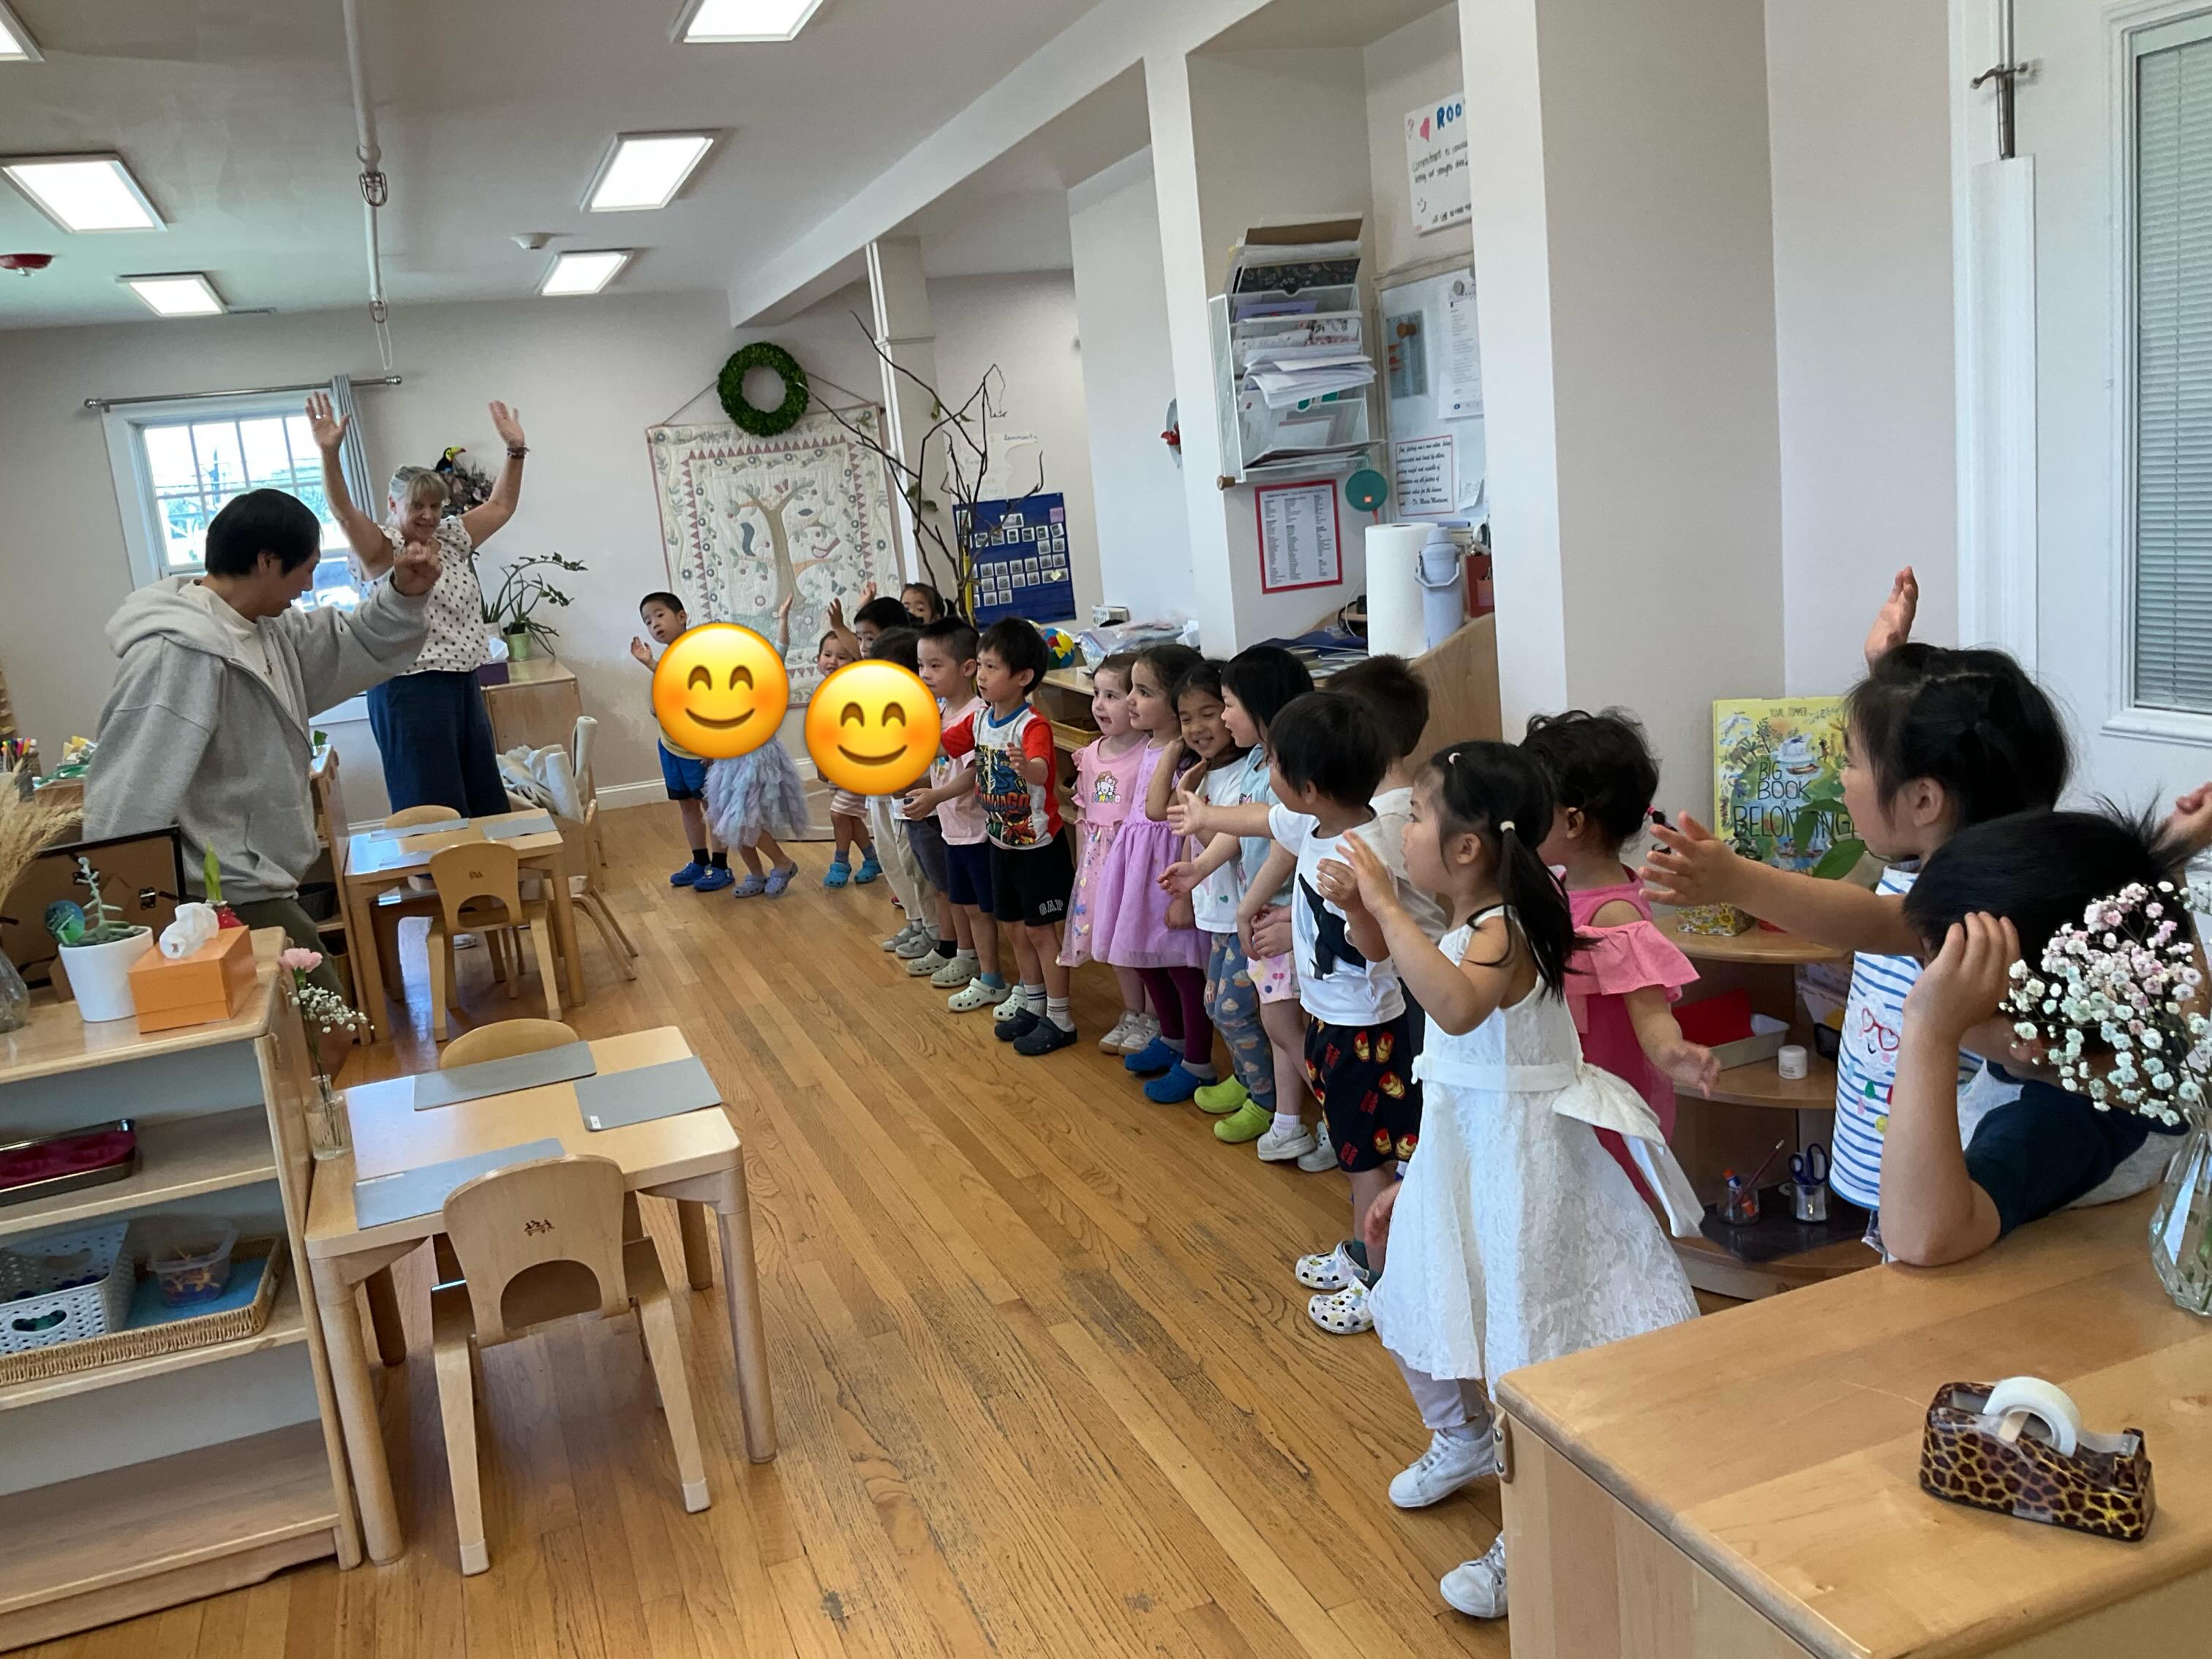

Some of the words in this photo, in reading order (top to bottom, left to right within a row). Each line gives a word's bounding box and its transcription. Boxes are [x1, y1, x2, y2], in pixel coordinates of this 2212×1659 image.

[1758, 761, 1783, 780] BIG
[1757, 780, 1812, 800] BOOK
[1733, 805, 1851, 839] BELONING
[1039, 899, 1064, 916] GAP
